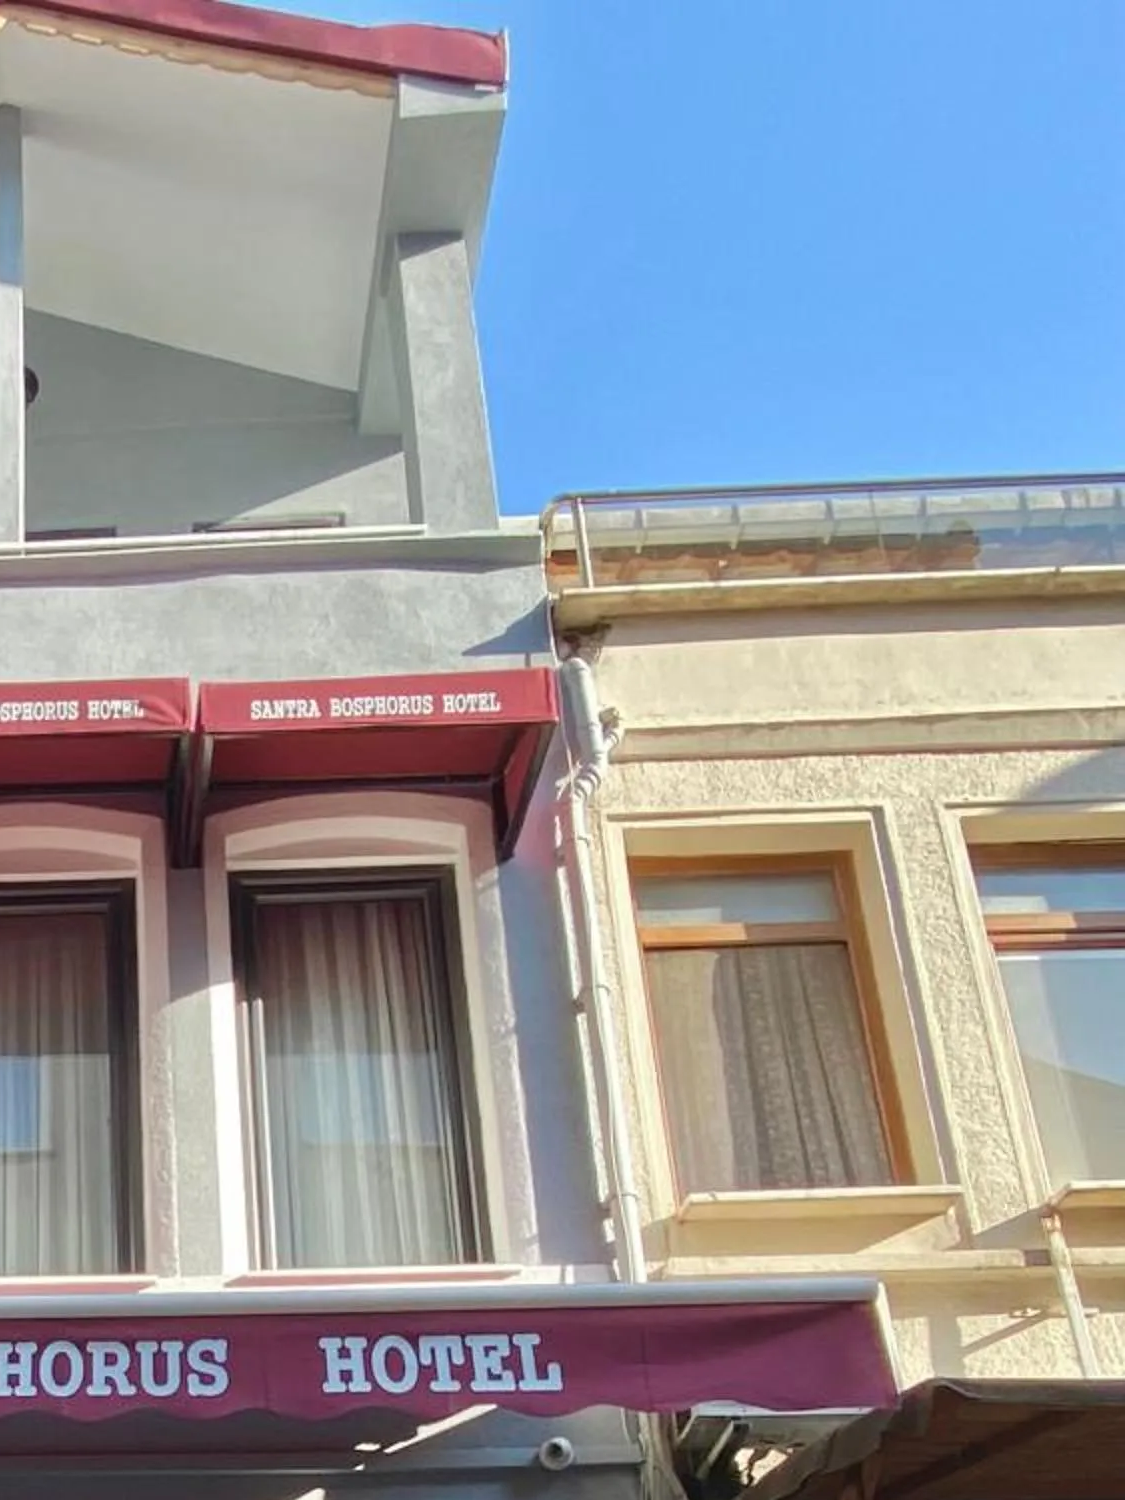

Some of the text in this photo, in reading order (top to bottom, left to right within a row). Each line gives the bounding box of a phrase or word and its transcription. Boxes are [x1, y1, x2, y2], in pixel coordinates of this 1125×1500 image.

[87, 699, 144, 719] HOTEL
[250, 692, 501, 720] SANTRA BOSPHORUS HOTEL
[319, 1332, 565, 1394] HOTEL
